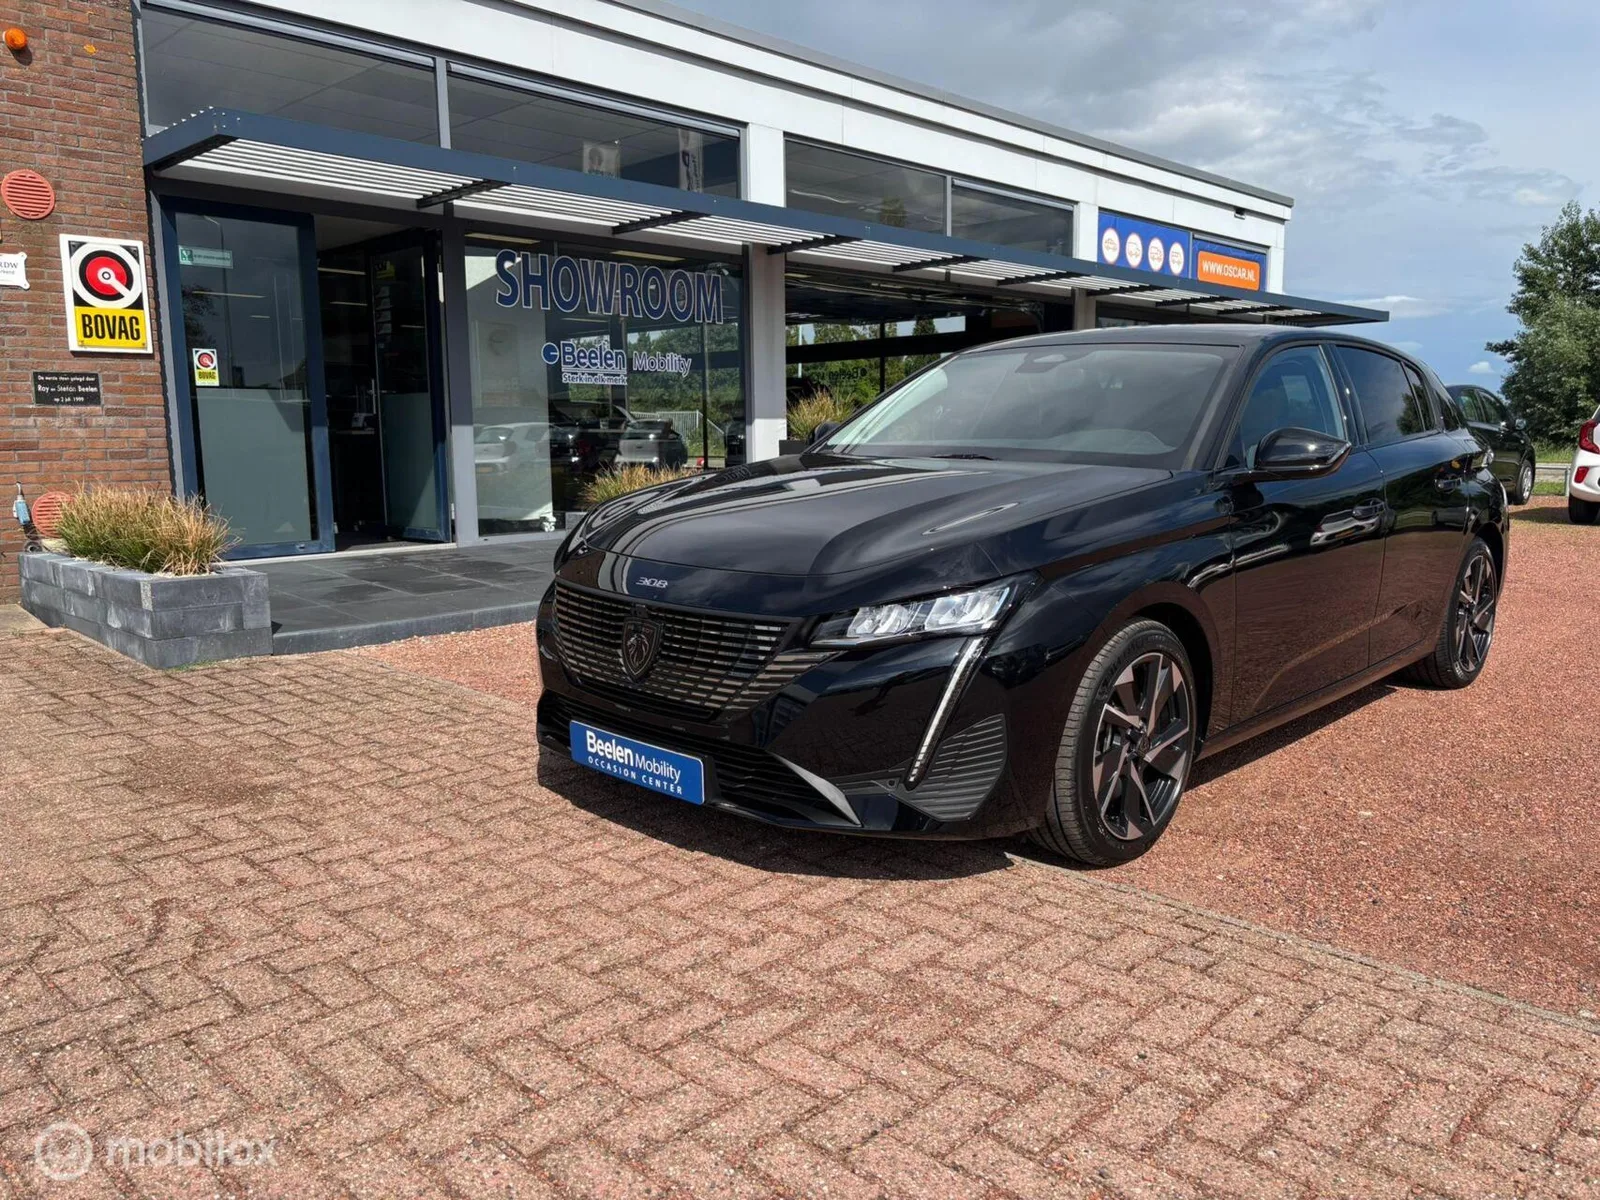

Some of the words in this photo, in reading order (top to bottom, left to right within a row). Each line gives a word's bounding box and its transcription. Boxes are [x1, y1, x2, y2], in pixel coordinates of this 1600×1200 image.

[1202, 260, 1256, 281] WWW.OSCAR.NL
[495, 248, 724, 325] SHOWROOM
[81, 313, 141, 341] BOVAG
[560, 340, 627, 369] Beelen
[633, 351, 692, 378] Mobility
[37, 384, 49, 393] Roy
[562, 372, 582, 383] Sterk
[604, 374, 628, 385] merk
[635, 576, 668, 588] 308
[586, 730, 634, 767] Beelen
[635, 752, 681, 784] Mobility
[587, 755, 637, 780] OCCASION
[641, 774, 683, 795] CENTER
